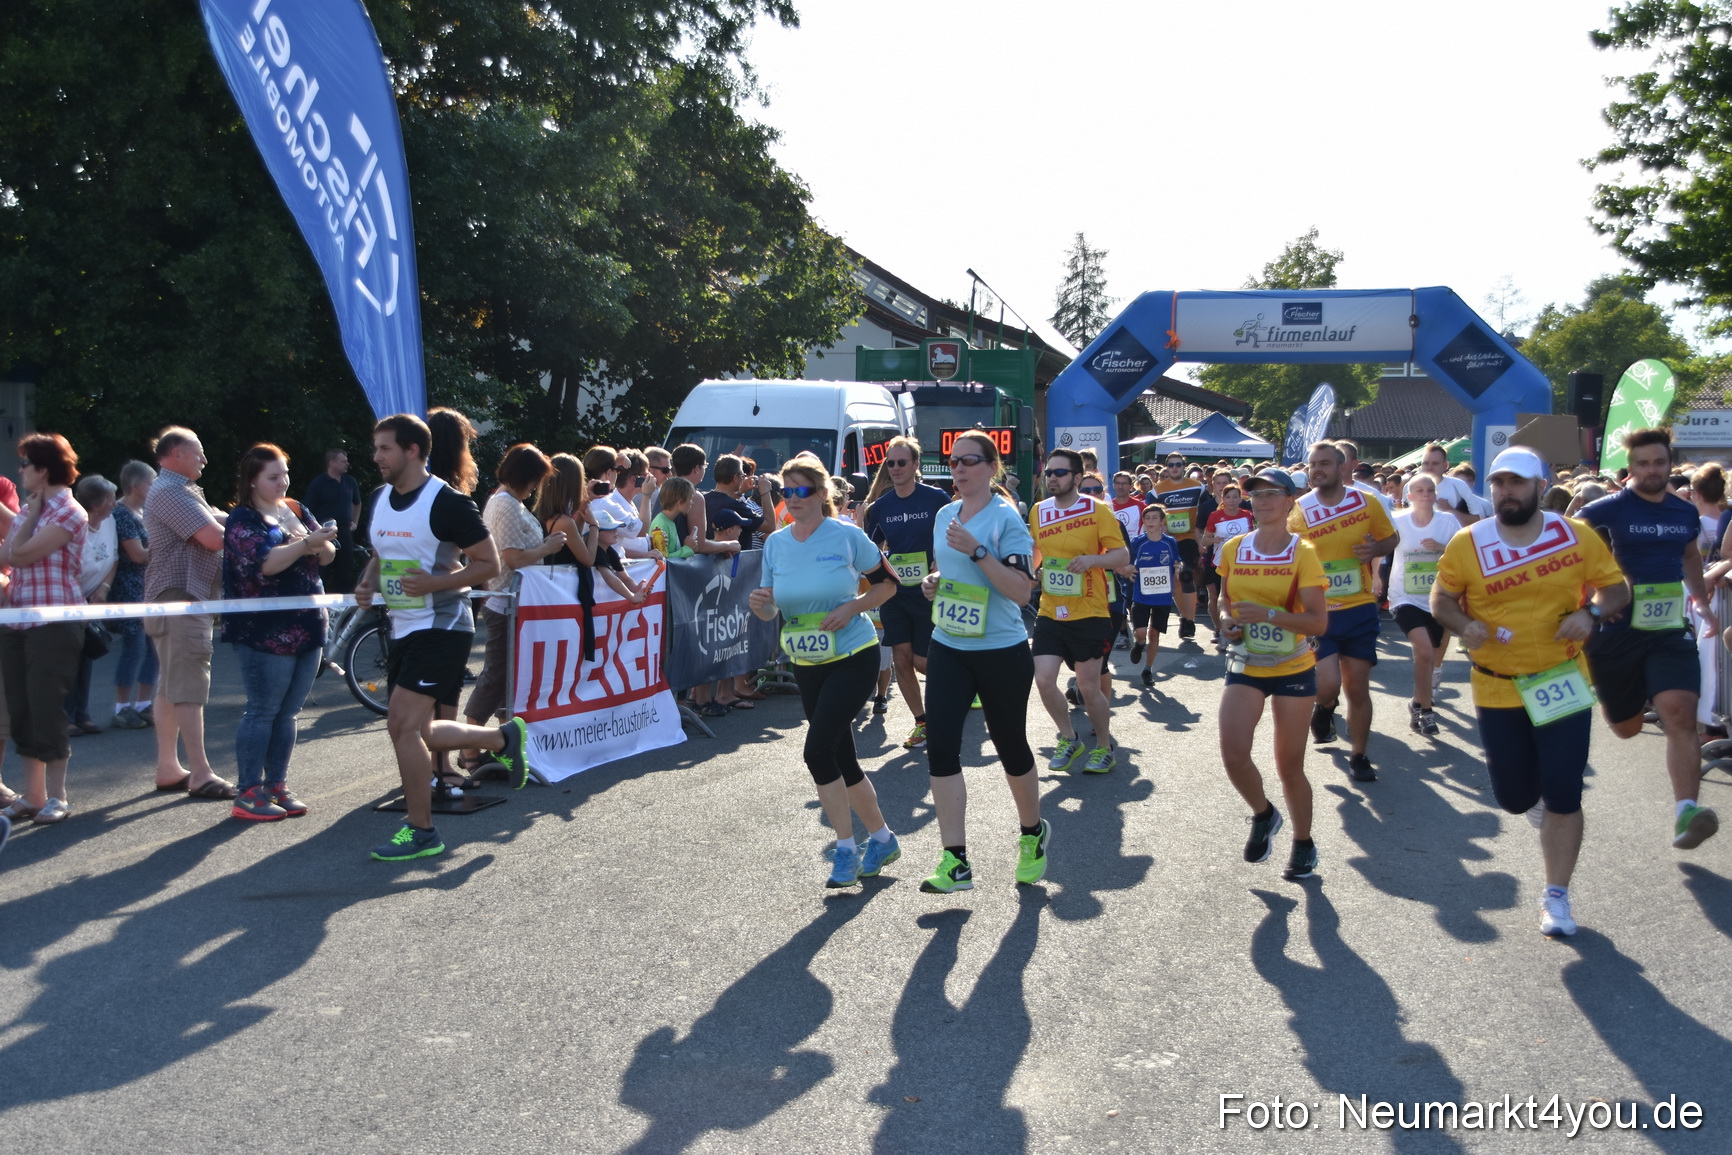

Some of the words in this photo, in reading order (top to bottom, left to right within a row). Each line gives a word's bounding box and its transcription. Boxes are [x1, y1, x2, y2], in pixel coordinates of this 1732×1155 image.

[1290, 310, 1320, 318] Fischer
[1267, 325, 1357, 342] firmenlauf
[1101, 358, 1148, 368] Fischer
[908, 511, 929, 521] POLES
[1170, 520, 1186, 529] 444
[1039, 526, 1064, 540] MAX
[1065, 517, 1097, 532] BÖGL
[1307, 523, 1338, 540] MAX
[1340, 511, 1371, 529] BÖGL
[1629, 524, 1656, 534] EURO
[1664, 525, 1688, 534] POLES
[897, 565, 921, 578] 365
[1049, 572, 1075, 587] 930
[1232, 567, 1260, 576] MAX
[1263, 566, 1294, 576] BÖGL
[1485, 570, 1532, 597] MAX
[1535, 551, 1584, 578] BÖGL
[386, 579, 403, 596] 59
[1143, 575, 1168, 587] 8938
[937, 600, 981, 626] 1425
[1642, 601, 1674, 618] 387
[1249, 623, 1284, 643] 896
[785, 633, 830, 653] 1429
[1534, 679, 1577, 708] 931
